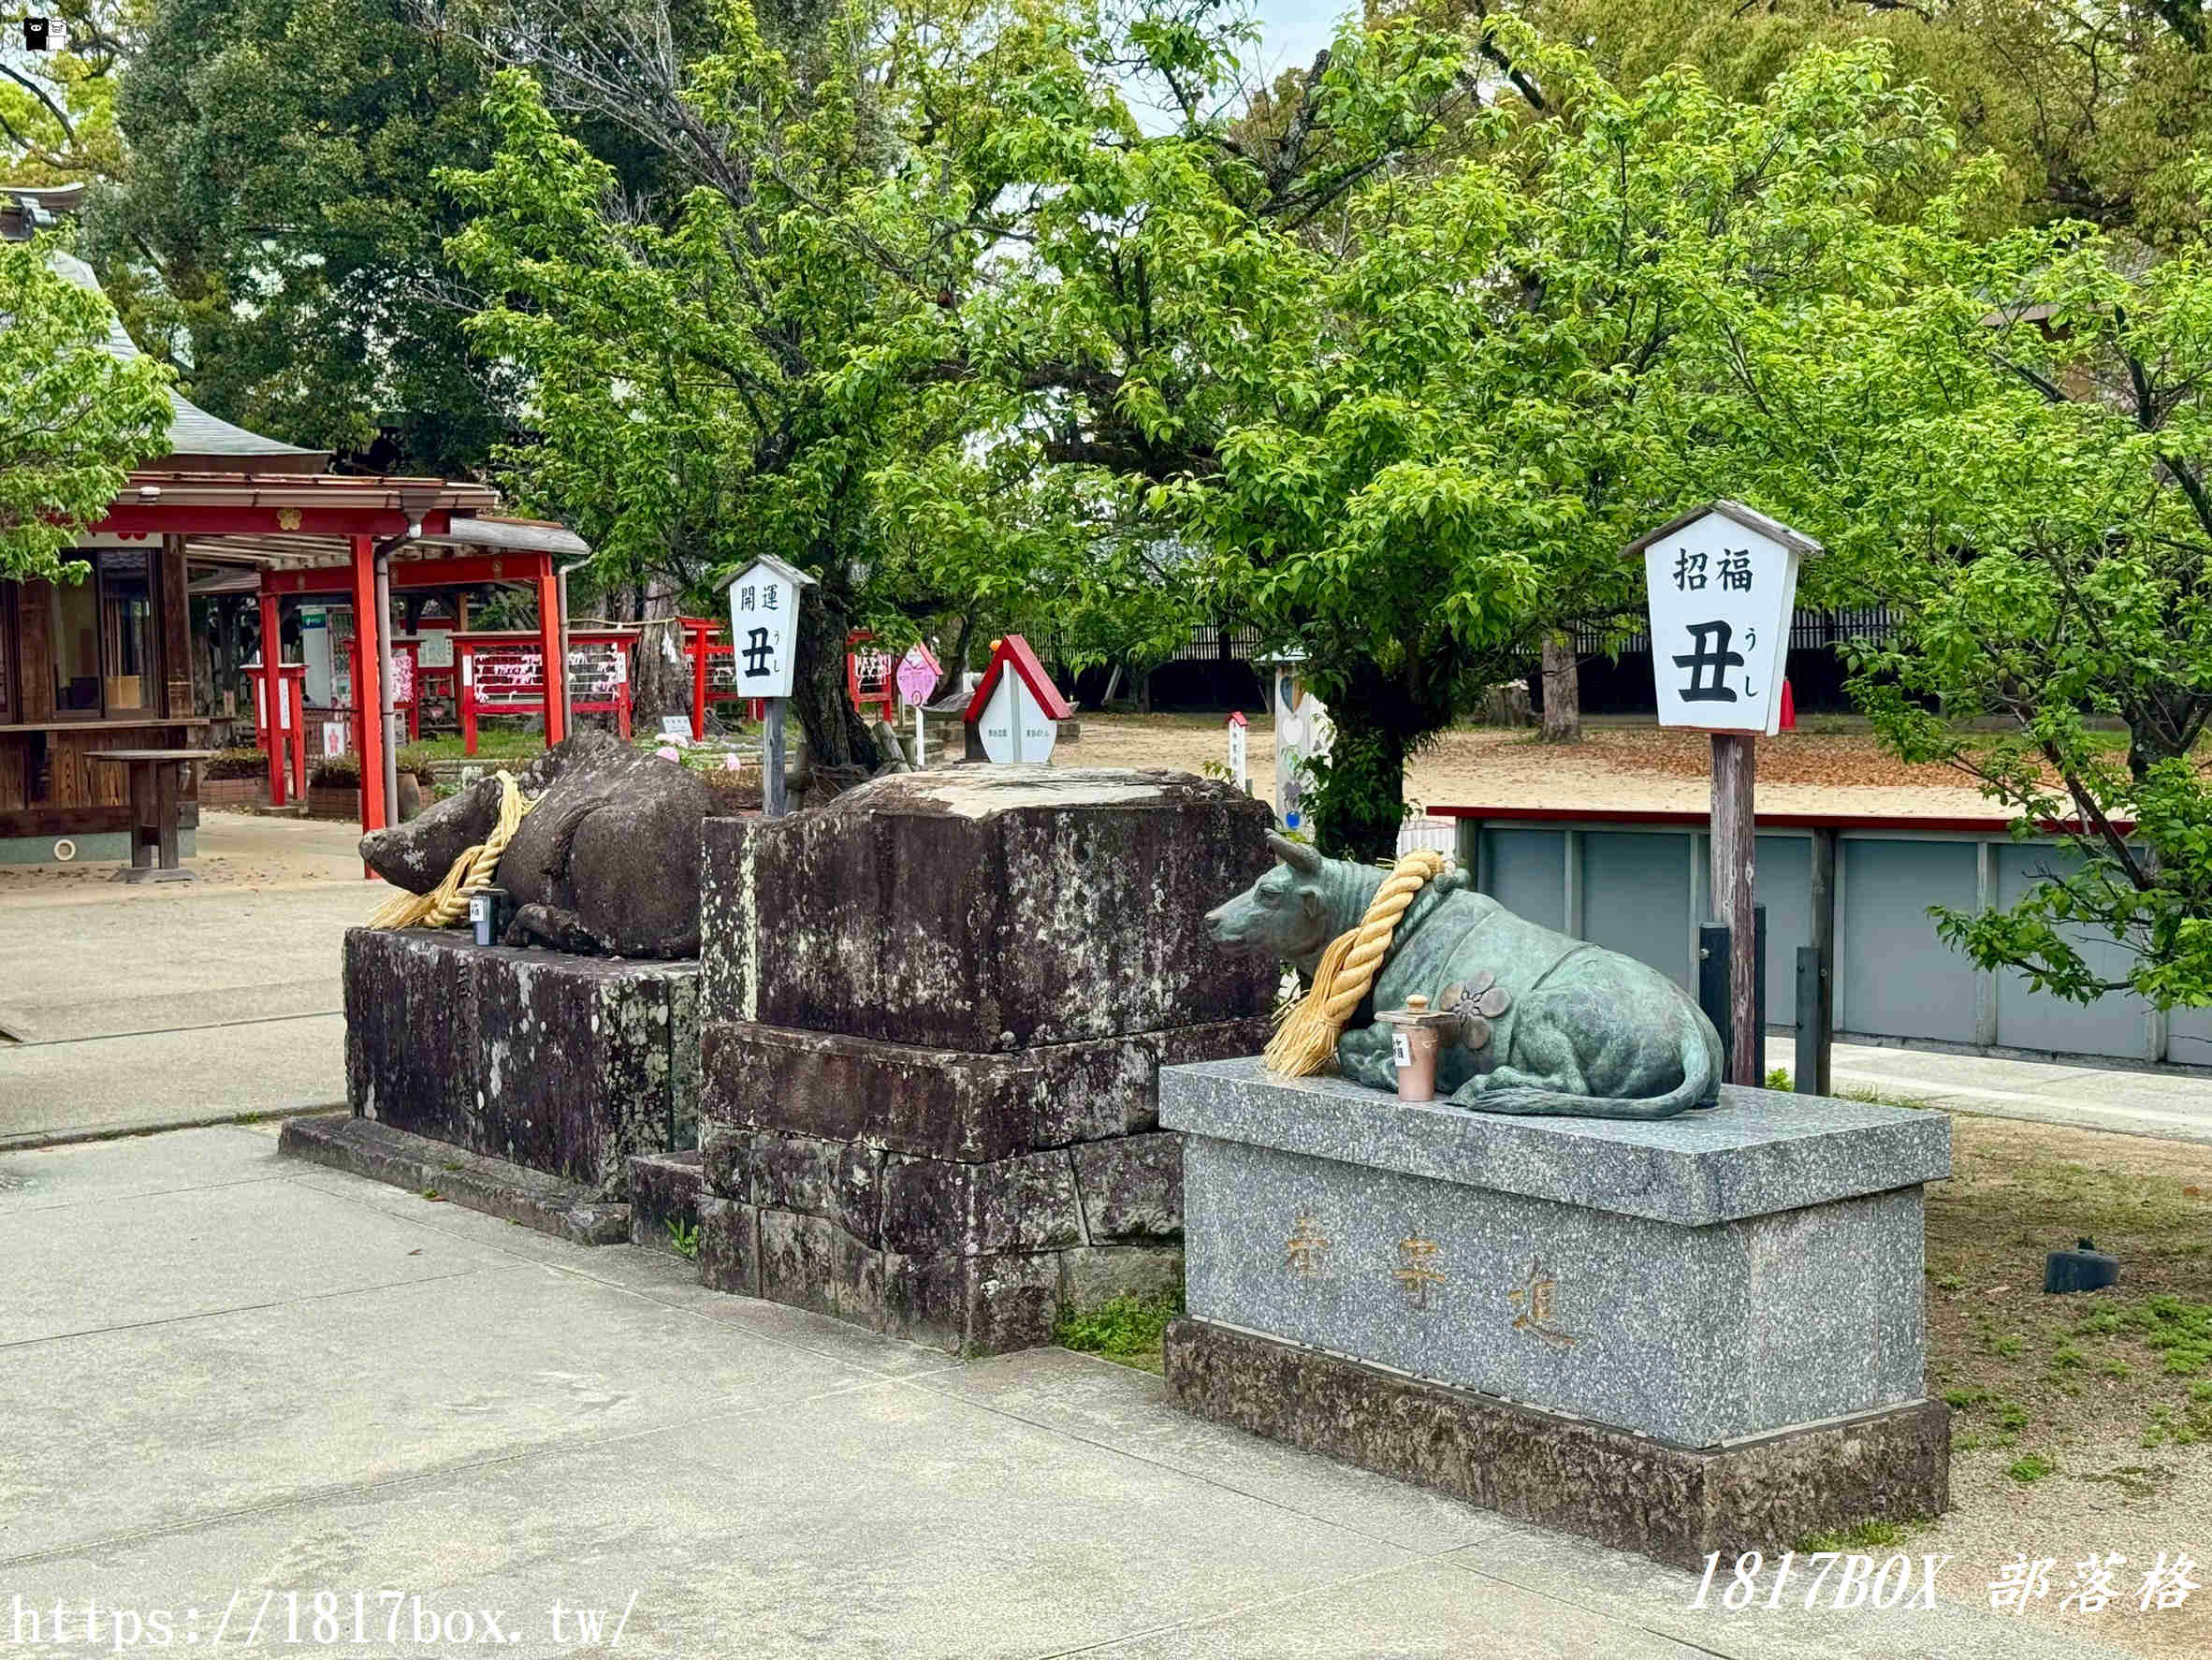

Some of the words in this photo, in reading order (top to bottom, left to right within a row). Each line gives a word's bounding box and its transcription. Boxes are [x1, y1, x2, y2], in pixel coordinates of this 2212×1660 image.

[1672, 547, 1754, 593] 招福
[741, 584, 779, 612] 開運
[741, 626, 775, 678] 丑
[773, 630, 780, 674] うし
[1672, 619, 1745, 703] 丑
[1745, 627, 1759, 698] うし
